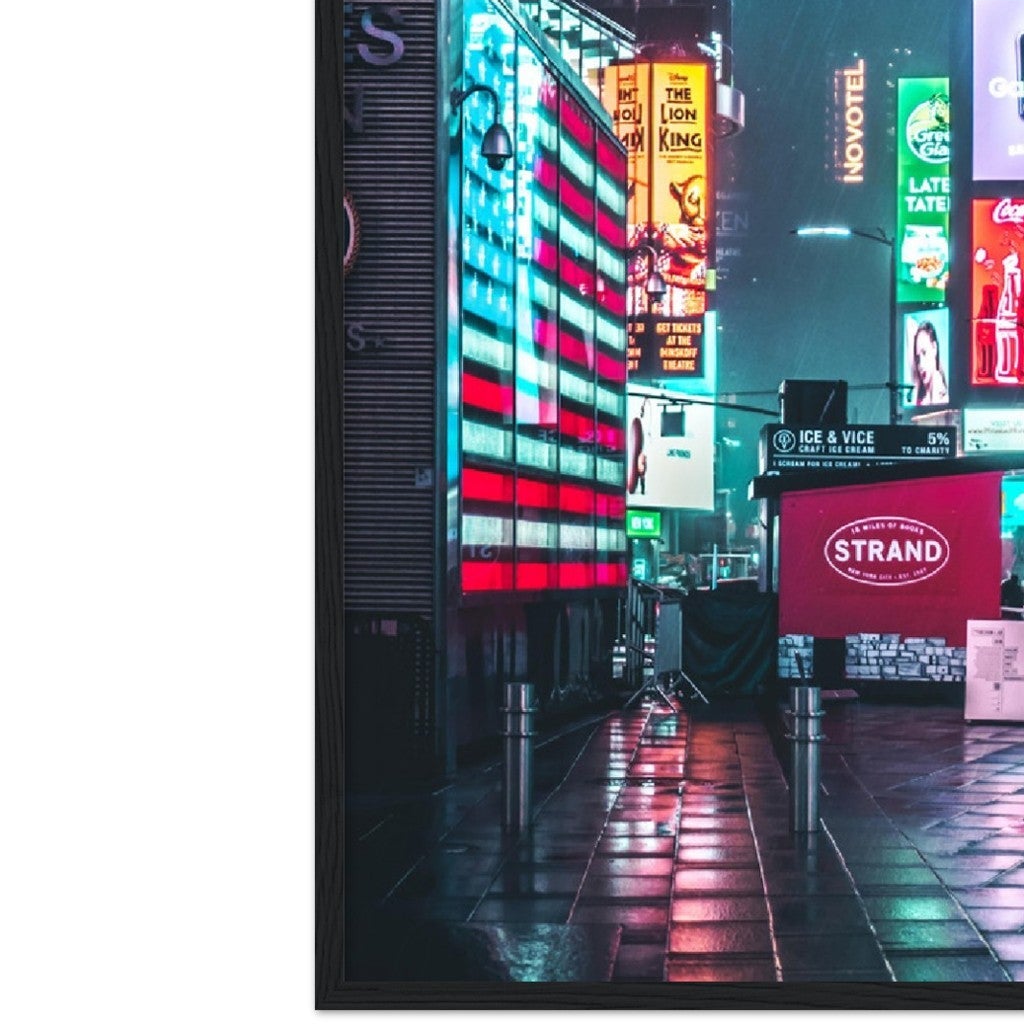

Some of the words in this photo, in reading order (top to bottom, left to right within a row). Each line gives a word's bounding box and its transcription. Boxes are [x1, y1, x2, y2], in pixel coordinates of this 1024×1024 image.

[665, 87, 692, 100] THE
[661, 103, 697, 124] LION
[843, 59, 864, 183] NOVOTEL
[659, 126, 702, 153] KING
[656, 322, 670, 333] GET
[672, 322, 702, 333] TICKETS
[666, 335, 676, 345] AT
[678, 335, 692, 345] THE
[663, 360, 695, 370] THEATRE
[799, 430, 823, 443] ICE
[827, 430, 836, 443] &
[842, 430, 874, 443] VICE
[928, 432, 950, 445] 5%
[863, 522, 885, 531] MILES
[835, 539, 942, 562] STRAND
